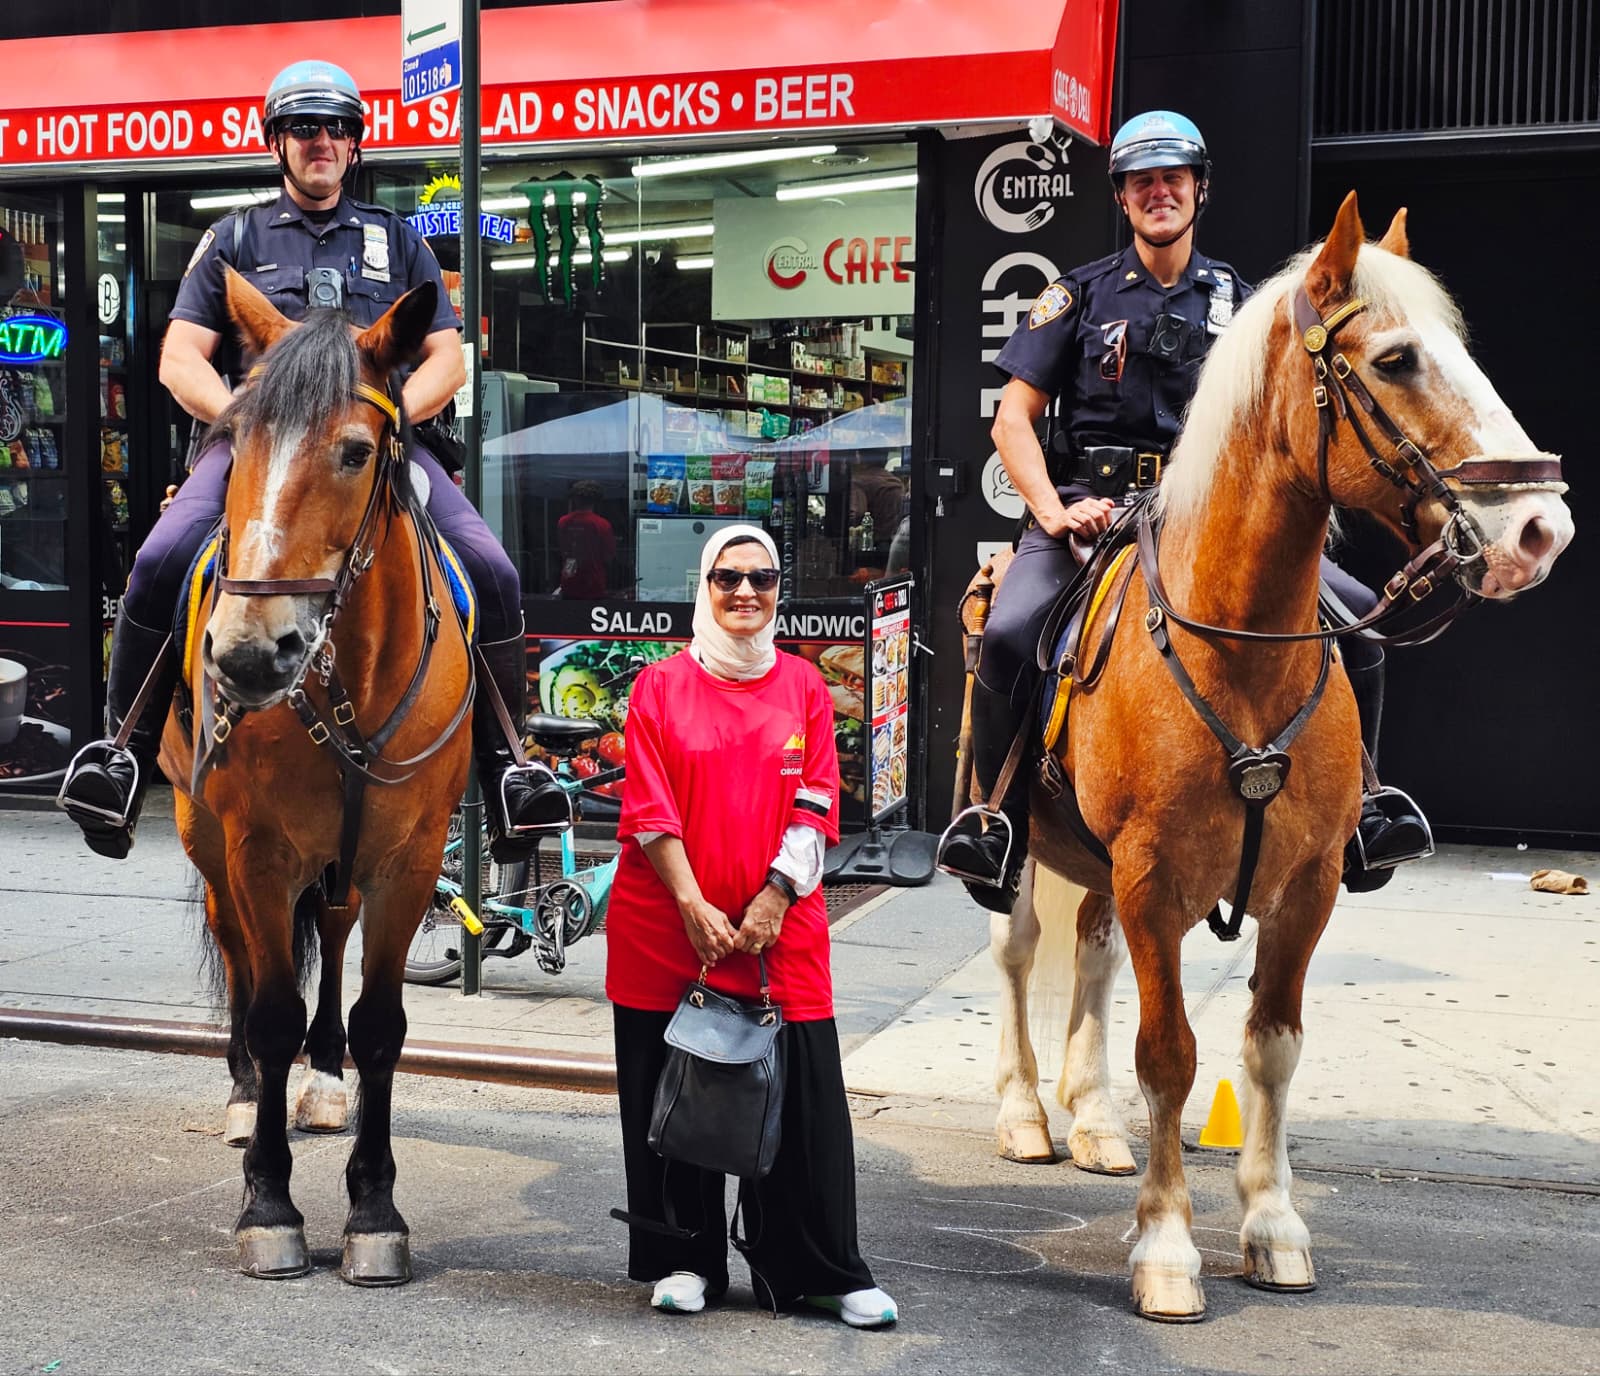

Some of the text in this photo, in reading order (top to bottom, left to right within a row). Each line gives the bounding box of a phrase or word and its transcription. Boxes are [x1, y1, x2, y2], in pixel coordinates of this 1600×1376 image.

[37, 114, 98, 157] HOT
[107, 109, 194, 153] FOOD
[221, 98, 395, 150] SACH
[427, 91, 542, 140] SAD
[573, 80, 721, 132] SNACKS
[754, 73, 856, 122] BEER
[823, 236, 913, 285] CAFE
[0, 321, 63, 357] ATM
[591, 606, 673, 634] SALAD
[774, 614, 865, 638] ANDWIC
[1248, 782, 1273, 795] 1302
